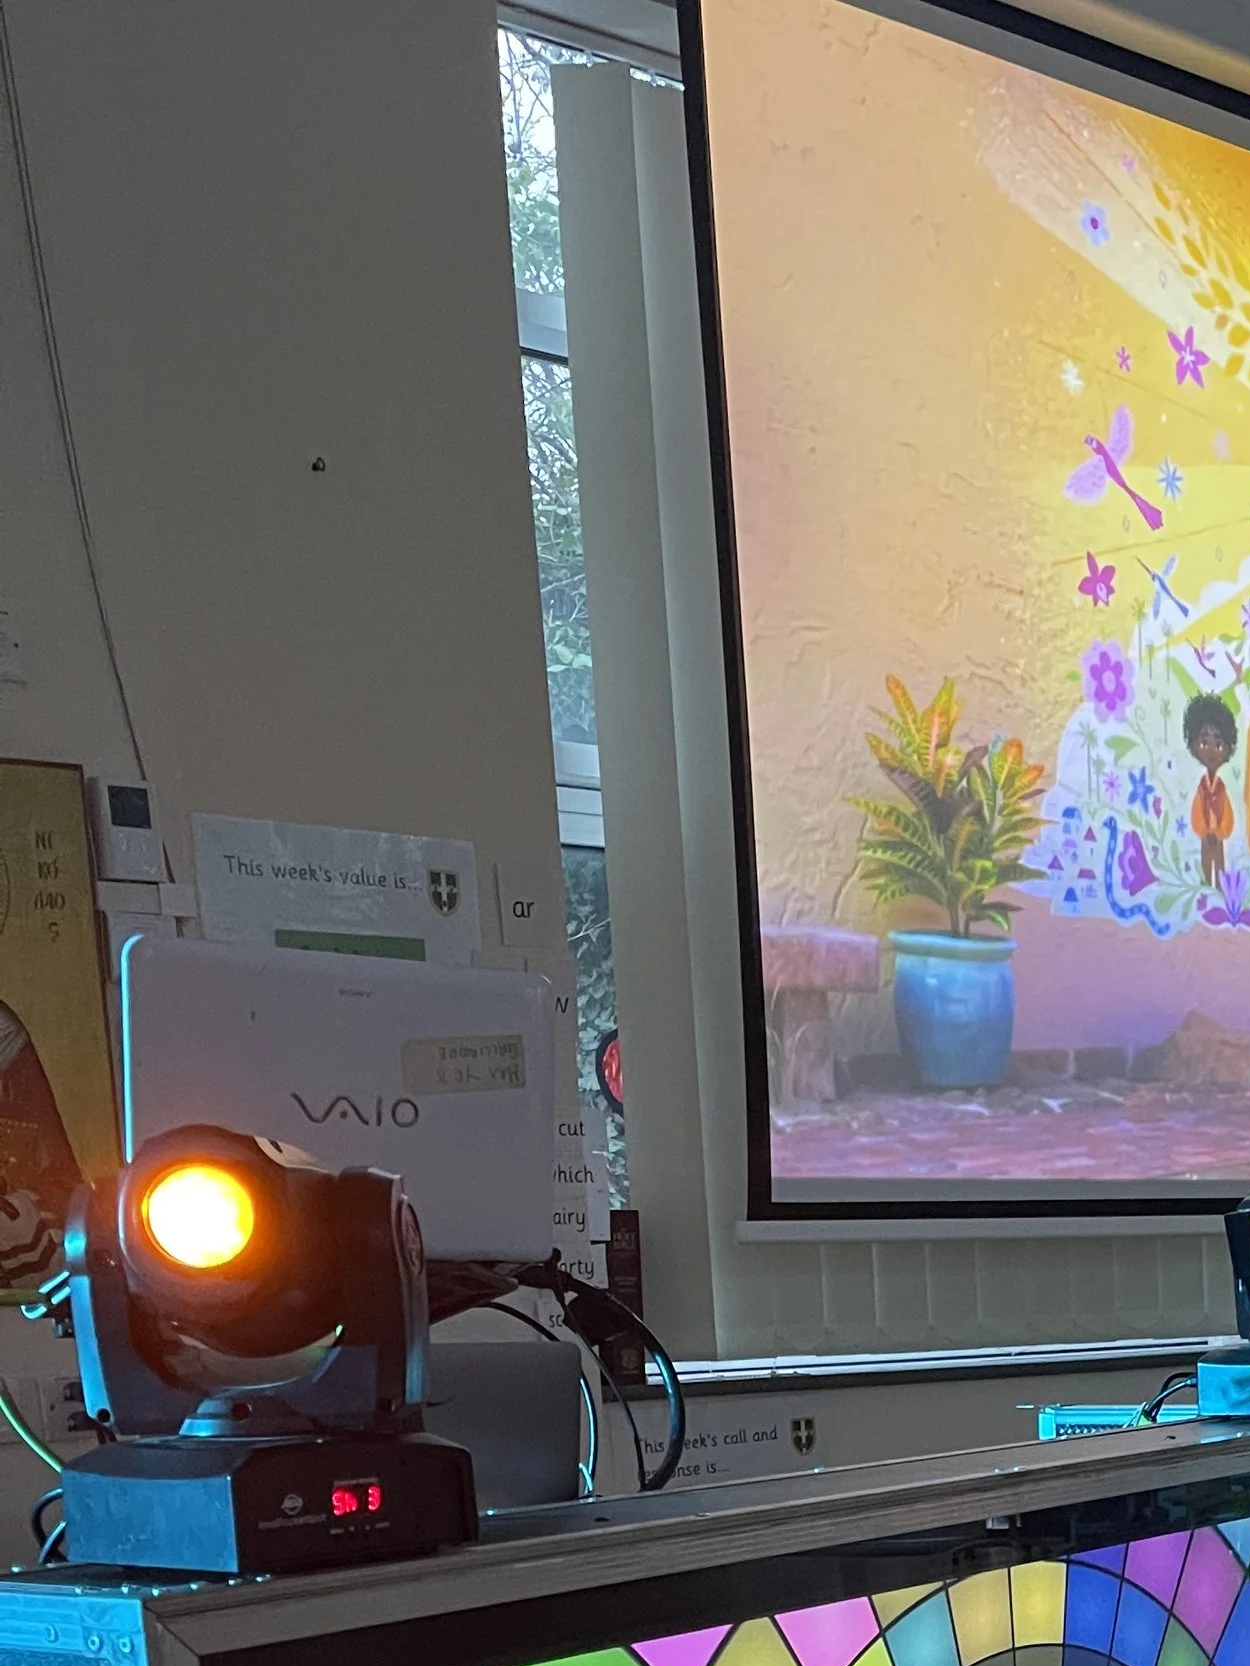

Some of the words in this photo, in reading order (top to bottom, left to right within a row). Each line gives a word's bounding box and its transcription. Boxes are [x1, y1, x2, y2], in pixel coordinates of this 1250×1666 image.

[223, 854, 263, 877] This
[271, 862, 332, 884] week's
[339, 867, 387, 888] value
[512, 900, 535, 918] ar
[290, 1092, 420, 1128] VAIO
[558, 1121, 586, 1137] cut
[553, 1163, 594, 1184] hich
[639, 1438, 665, 1454] his
[684, 1432, 718, 1450] eek's
[724, 1428, 748, 1446] call
[752, 1424, 778, 1442] and
